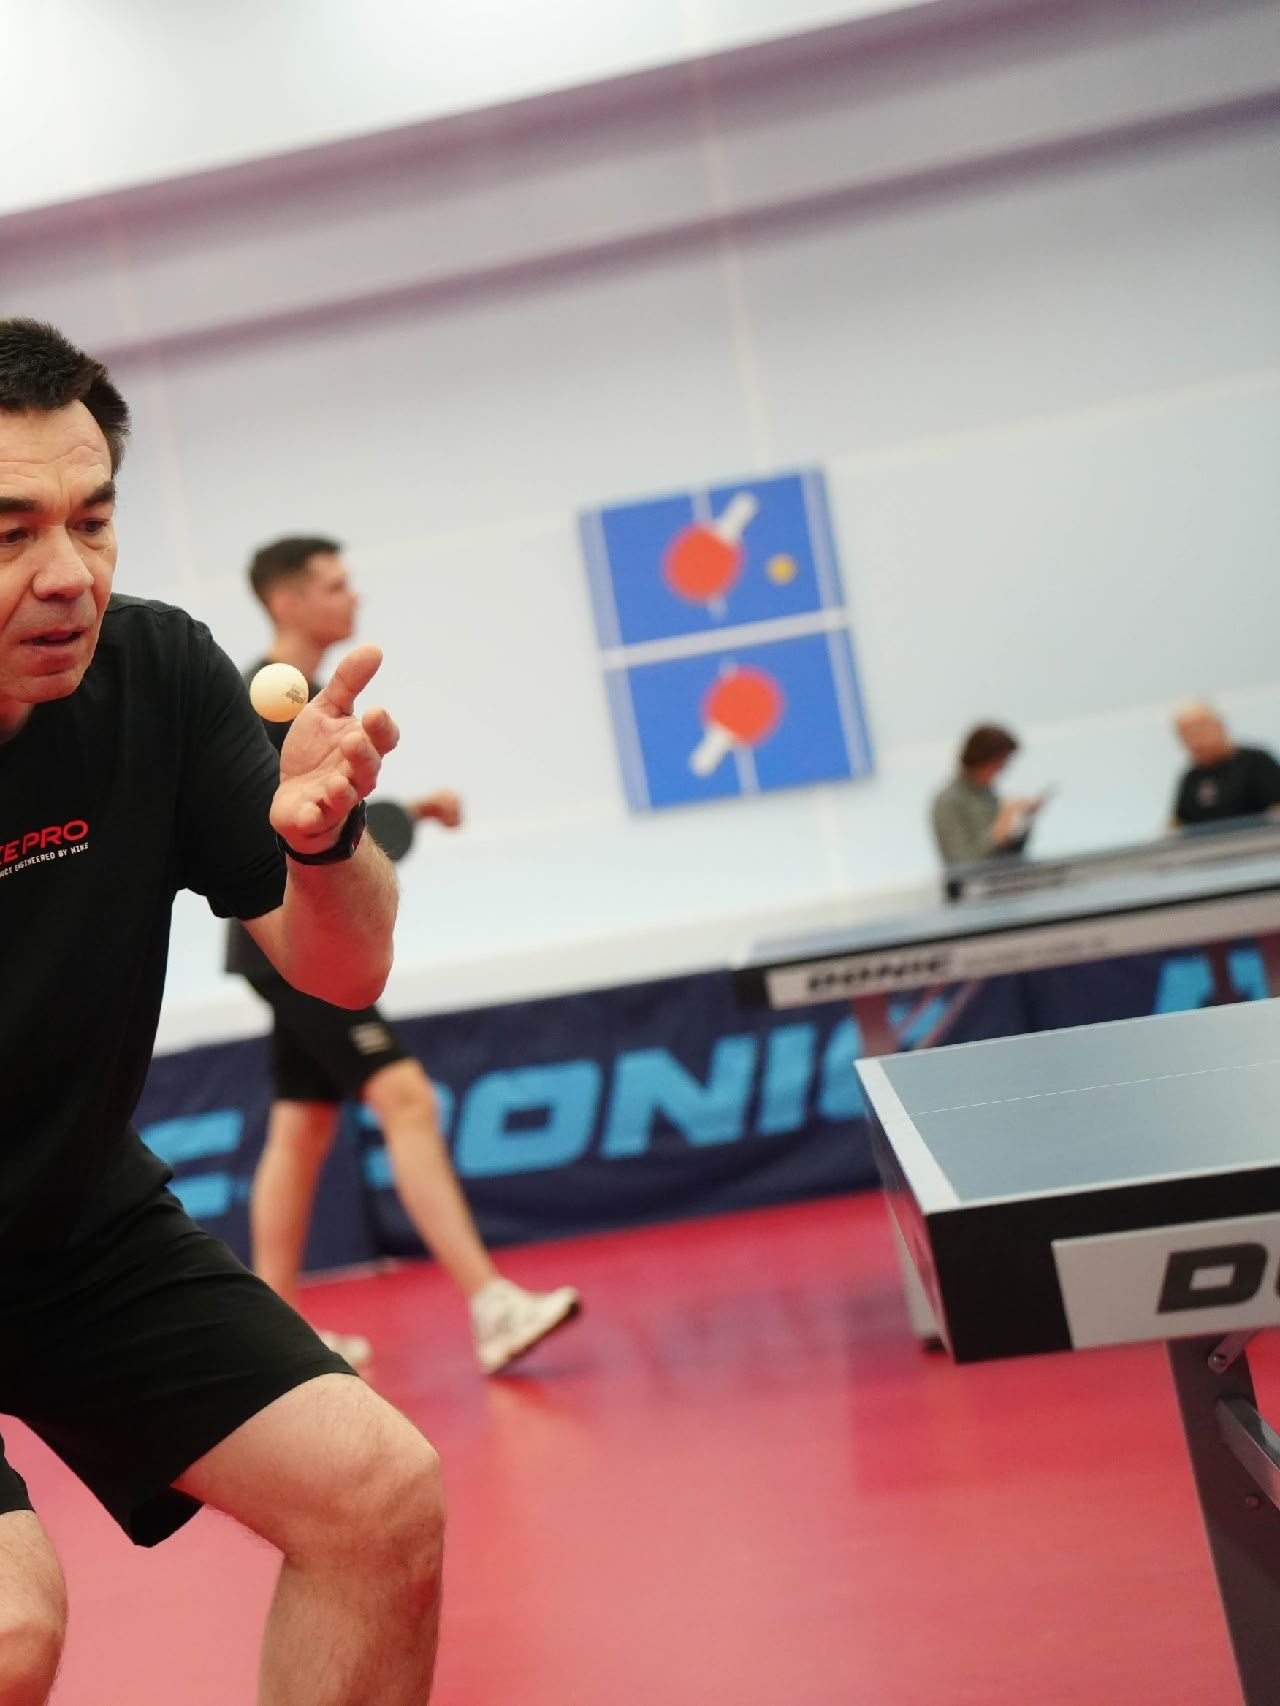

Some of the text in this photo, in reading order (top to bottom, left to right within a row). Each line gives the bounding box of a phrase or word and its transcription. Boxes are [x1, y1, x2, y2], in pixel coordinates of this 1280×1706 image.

[22, 819, 89, 855] PRO
[14, 851, 56, 872] ENGINEERED
[57, 848, 68, 858] BY
[70, 841, 89, 855] NIKE
